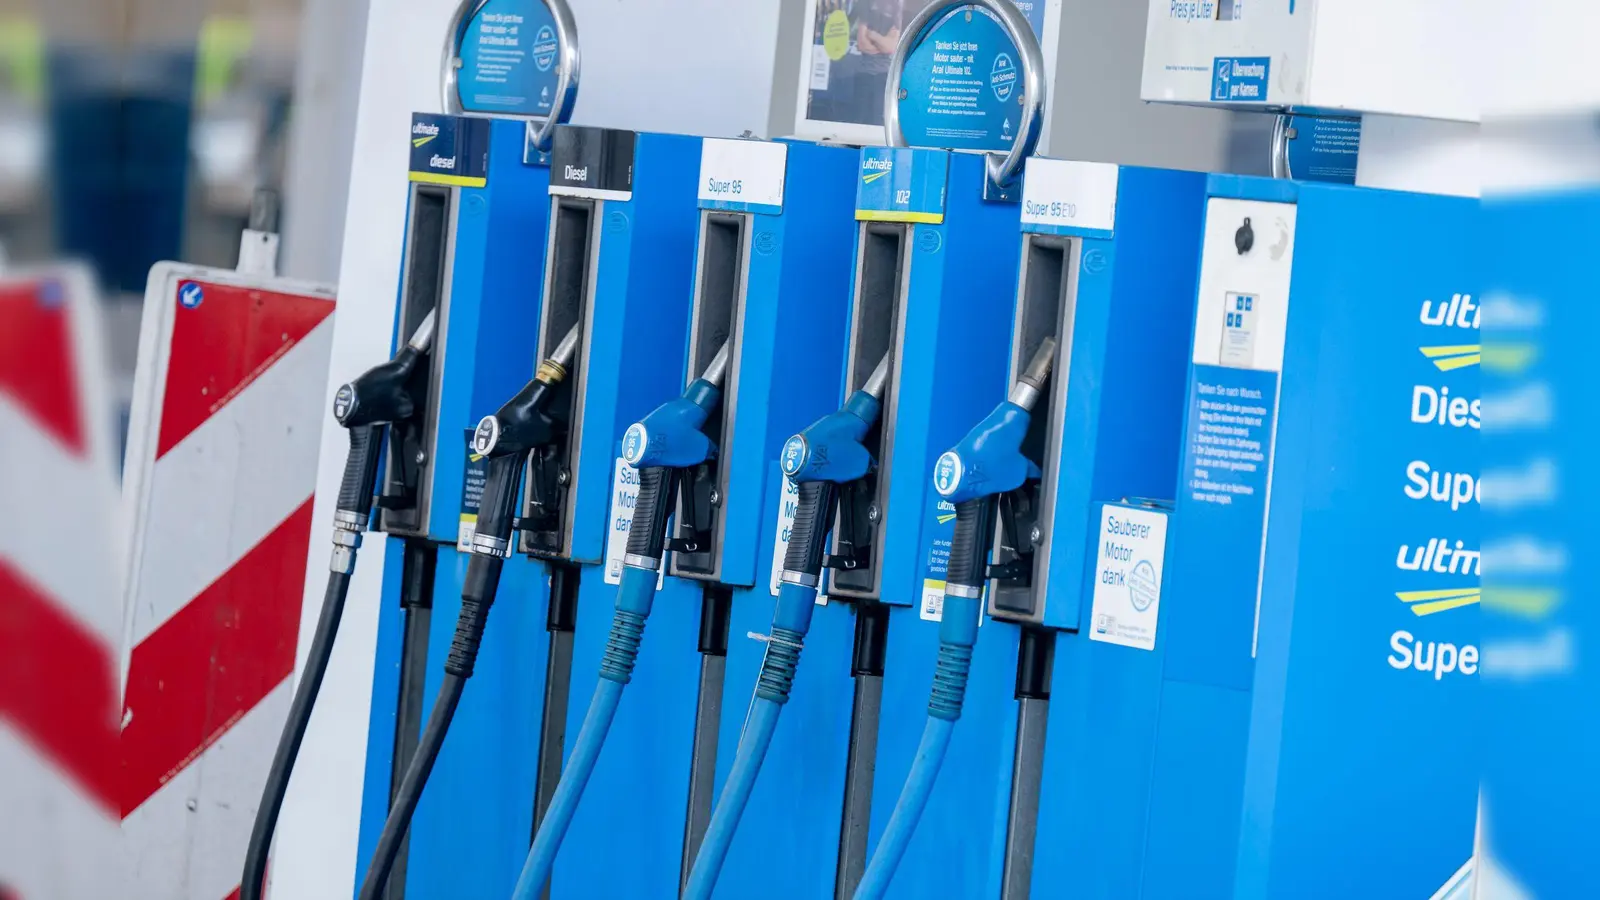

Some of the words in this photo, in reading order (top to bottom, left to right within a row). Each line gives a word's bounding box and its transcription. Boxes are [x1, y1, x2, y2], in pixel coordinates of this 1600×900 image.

[934, 52, 949, 62] Motor
[412, 122, 439, 135] ultimate
[429, 153, 456, 169] diesel
[862, 157, 893, 170] ultimate
[565, 165, 587, 181] Diesel
[709, 177, 730, 195] Super
[731, 180, 742, 194] 95
[895, 190, 911, 204] 102
[1026, 200, 1048, 218] Super
[1107, 515, 1151, 539] Sauberer
[1105, 541, 1134, 562] Motor
[1102, 566, 1125, 587] dank
[1387, 630, 1480, 681] Supe
